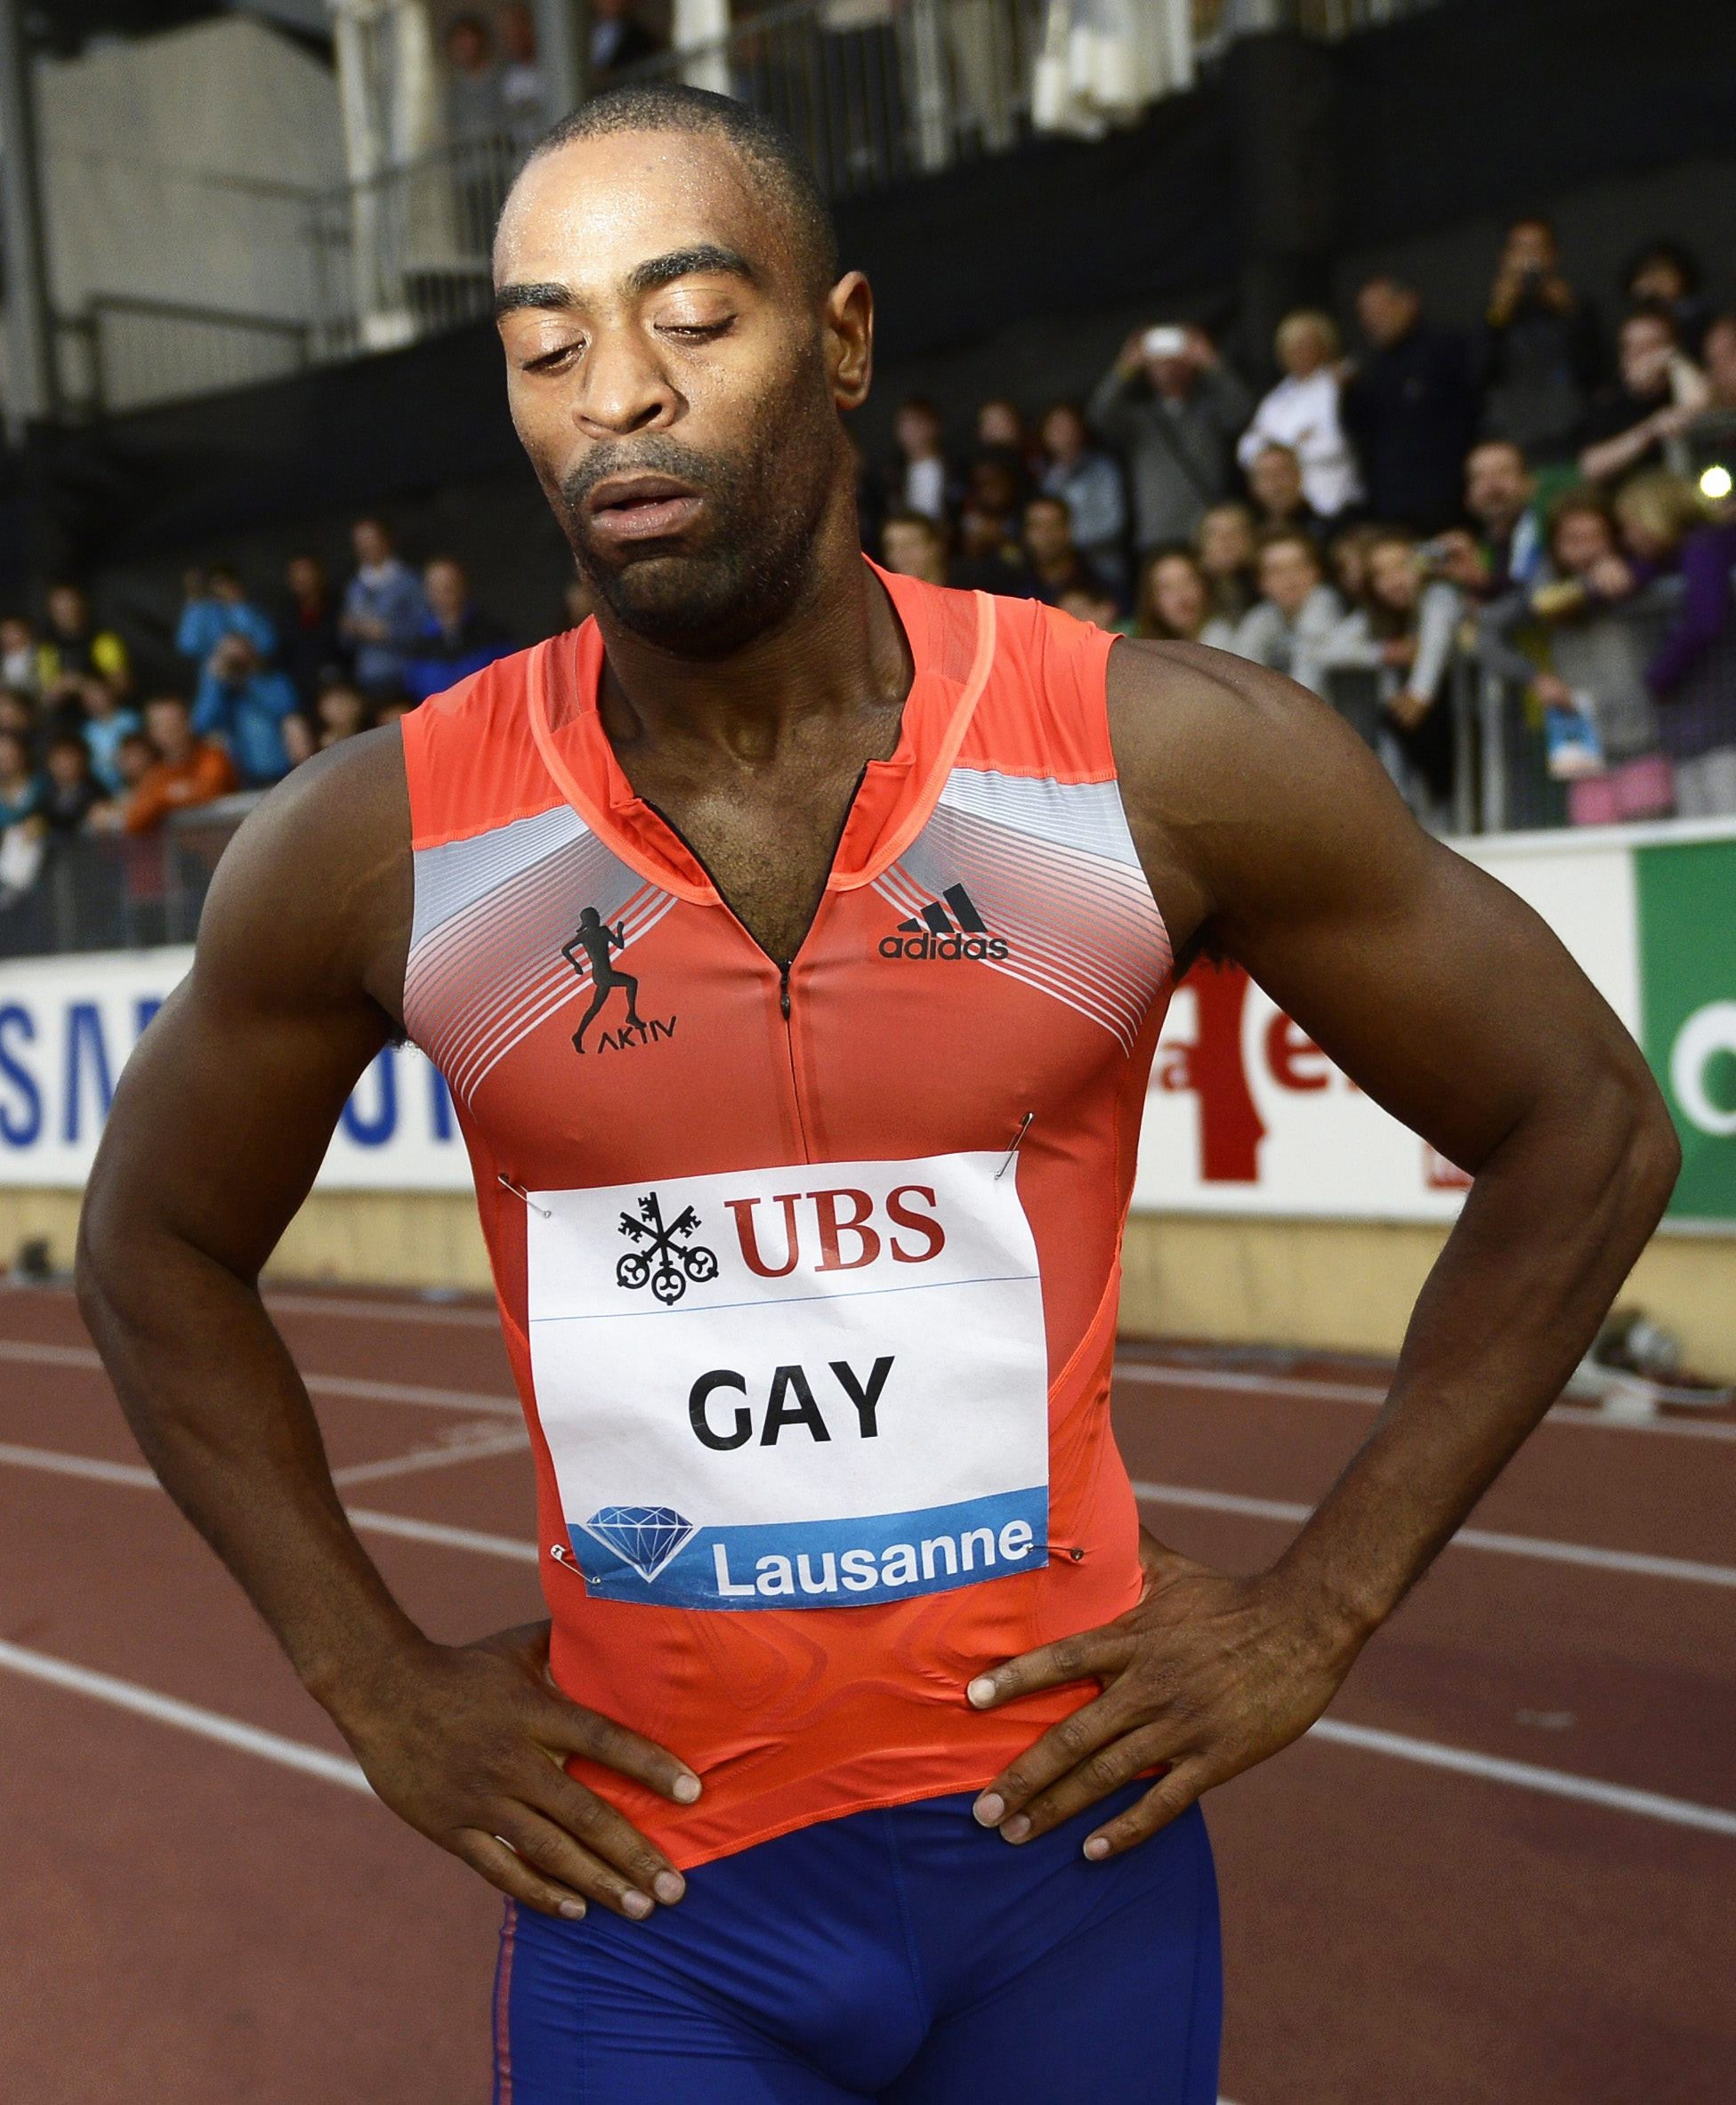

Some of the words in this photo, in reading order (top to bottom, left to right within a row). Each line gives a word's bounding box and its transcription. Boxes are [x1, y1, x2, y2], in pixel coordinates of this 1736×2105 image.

[878, 933, 1009, 961] adidas
[723, 1185, 946, 1278] UBS
[689, 1356, 895, 1451] GAY
[713, 1520, 1033, 1596] Lausanne
